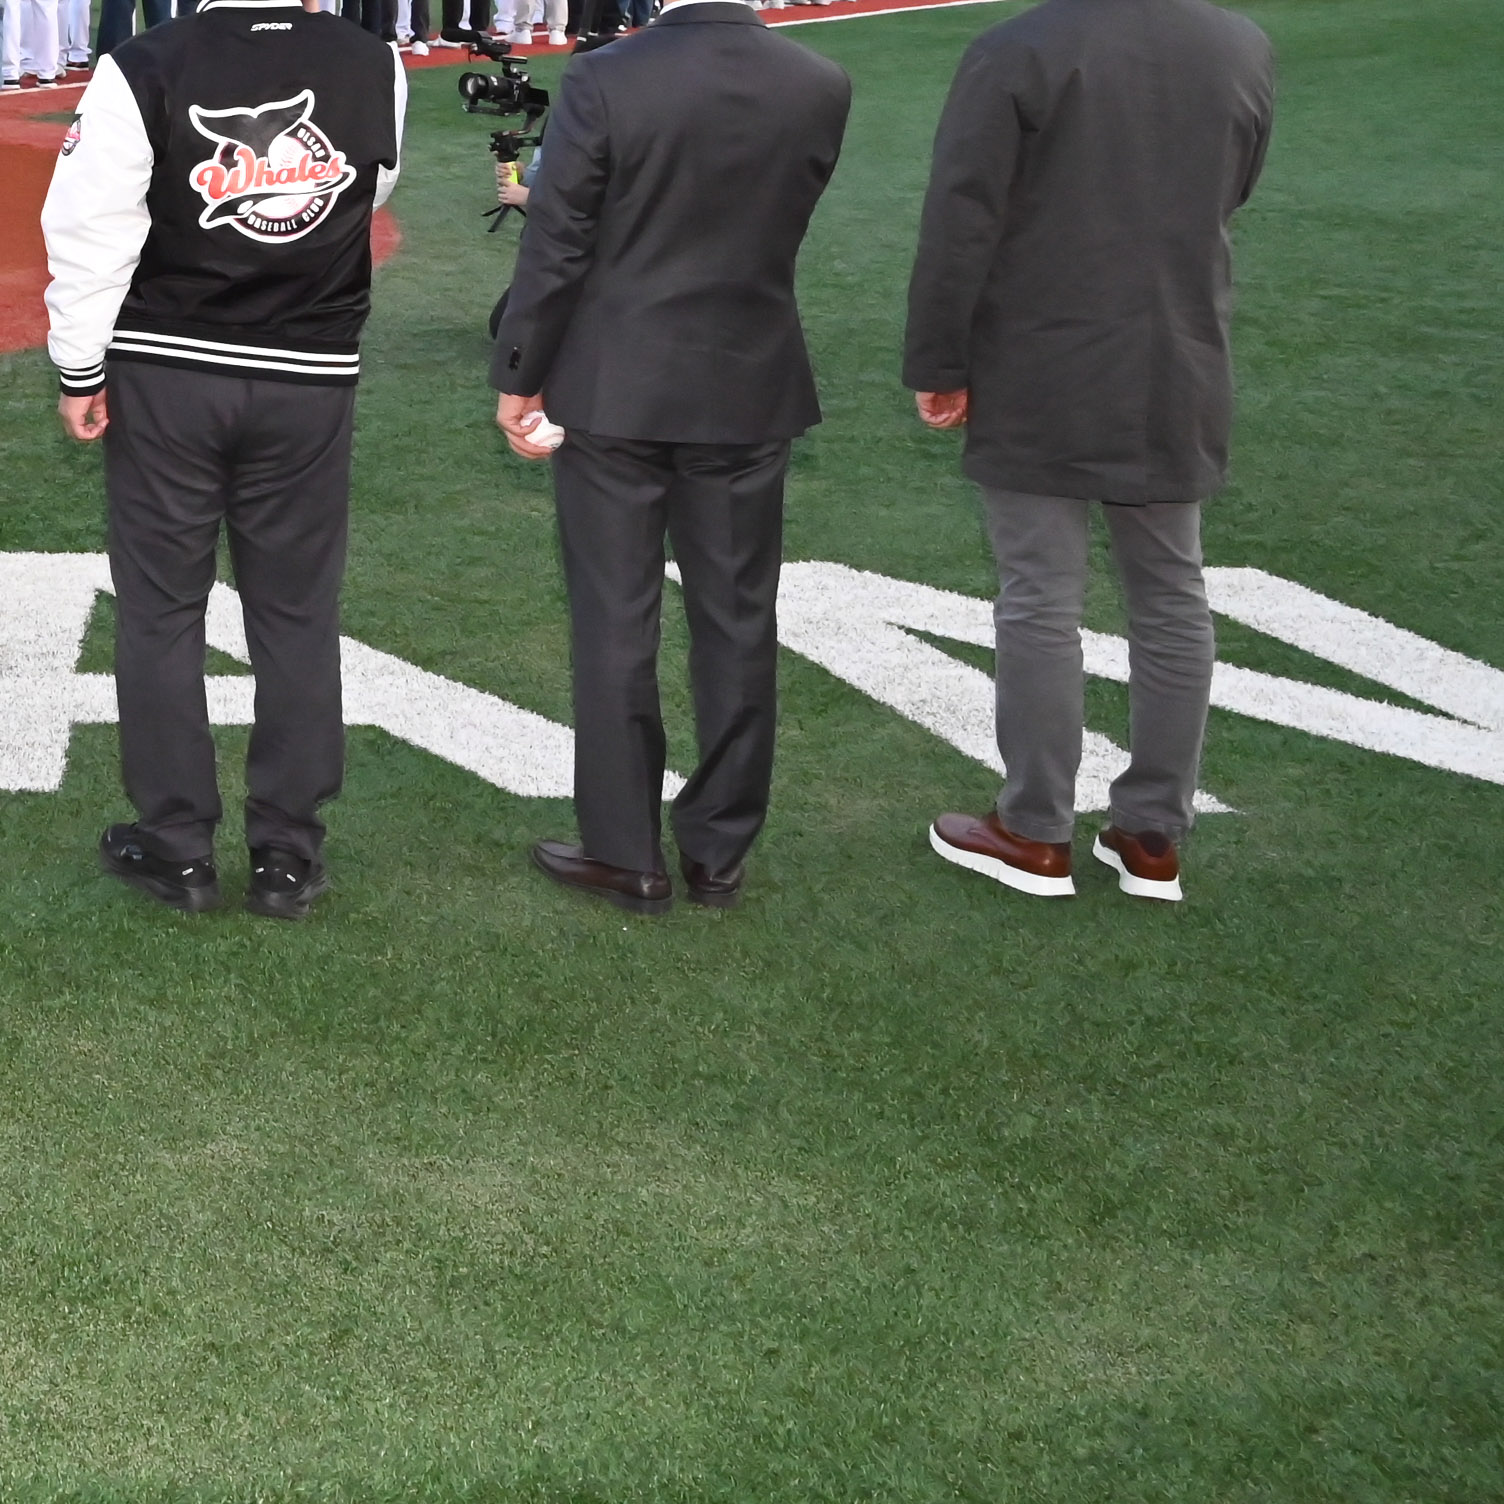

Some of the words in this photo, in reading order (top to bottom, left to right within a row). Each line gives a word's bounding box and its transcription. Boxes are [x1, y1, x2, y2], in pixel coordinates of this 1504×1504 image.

[250, 23, 293, 31] SPYDER
[296, 127, 327, 158] ULSAN
[196, 148, 344, 200] Whales
[246, 215, 298, 233] BASEBALL
[301, 197, 325, 223] CLUB
